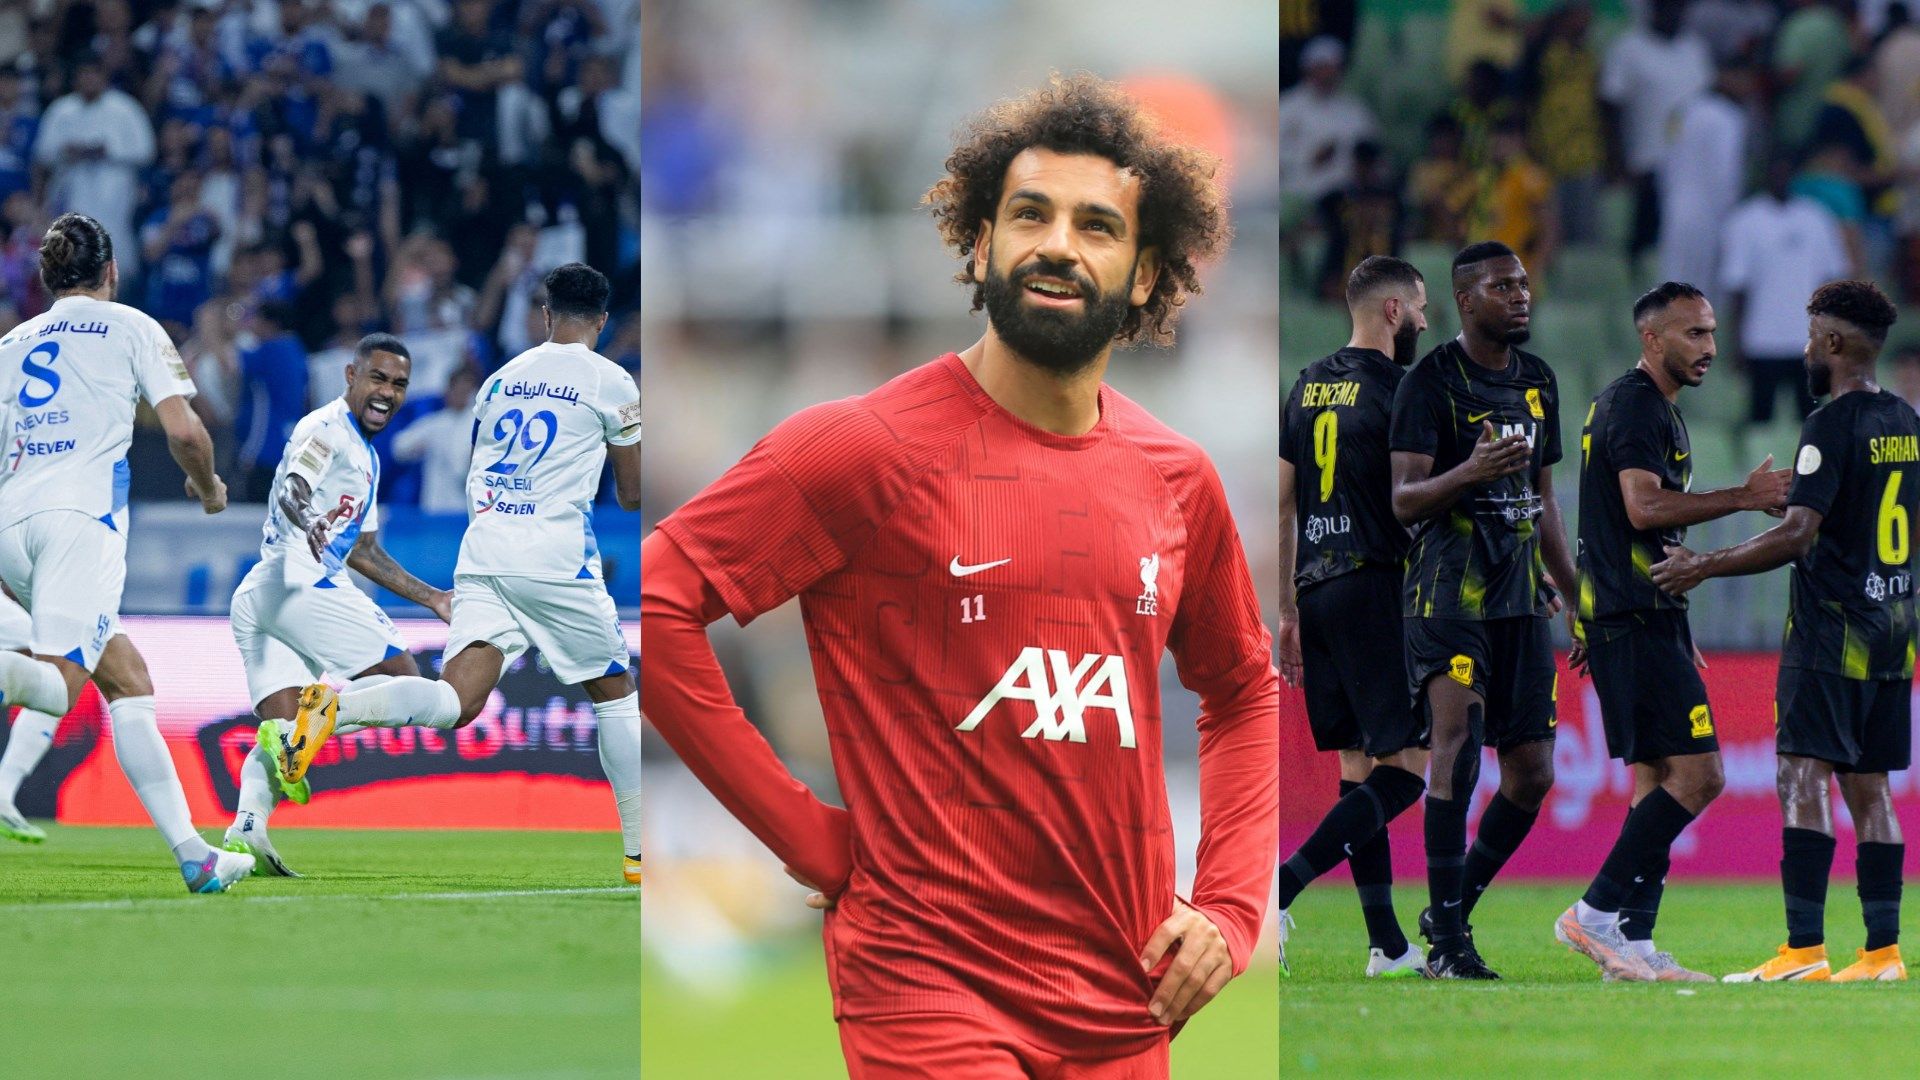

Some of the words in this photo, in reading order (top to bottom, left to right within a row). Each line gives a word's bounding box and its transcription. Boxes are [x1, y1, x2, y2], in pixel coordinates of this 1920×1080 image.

[70, 322, 109, 338] بنك
[18, 341, 61, 408] 8
[505, 381, 547, 400] الرياض
[547, 385, 579, 406] بنك
[1302, 381, 1361, 408] BENZEMA
[15, 410, 69, 432] NEVES
[27, 439, 76, 456] SEVEN
[484, 408, 558, 475] 29
[1313, 410, 1339, 503] 9
[485, 475, 532, 491] SALEM
[495, 501, 536, 515] SEVEN
[1877, 470, 1910, 565] 6
[960, 594, 986, 623] 11
[955, 647, 1136, 749] AXA
